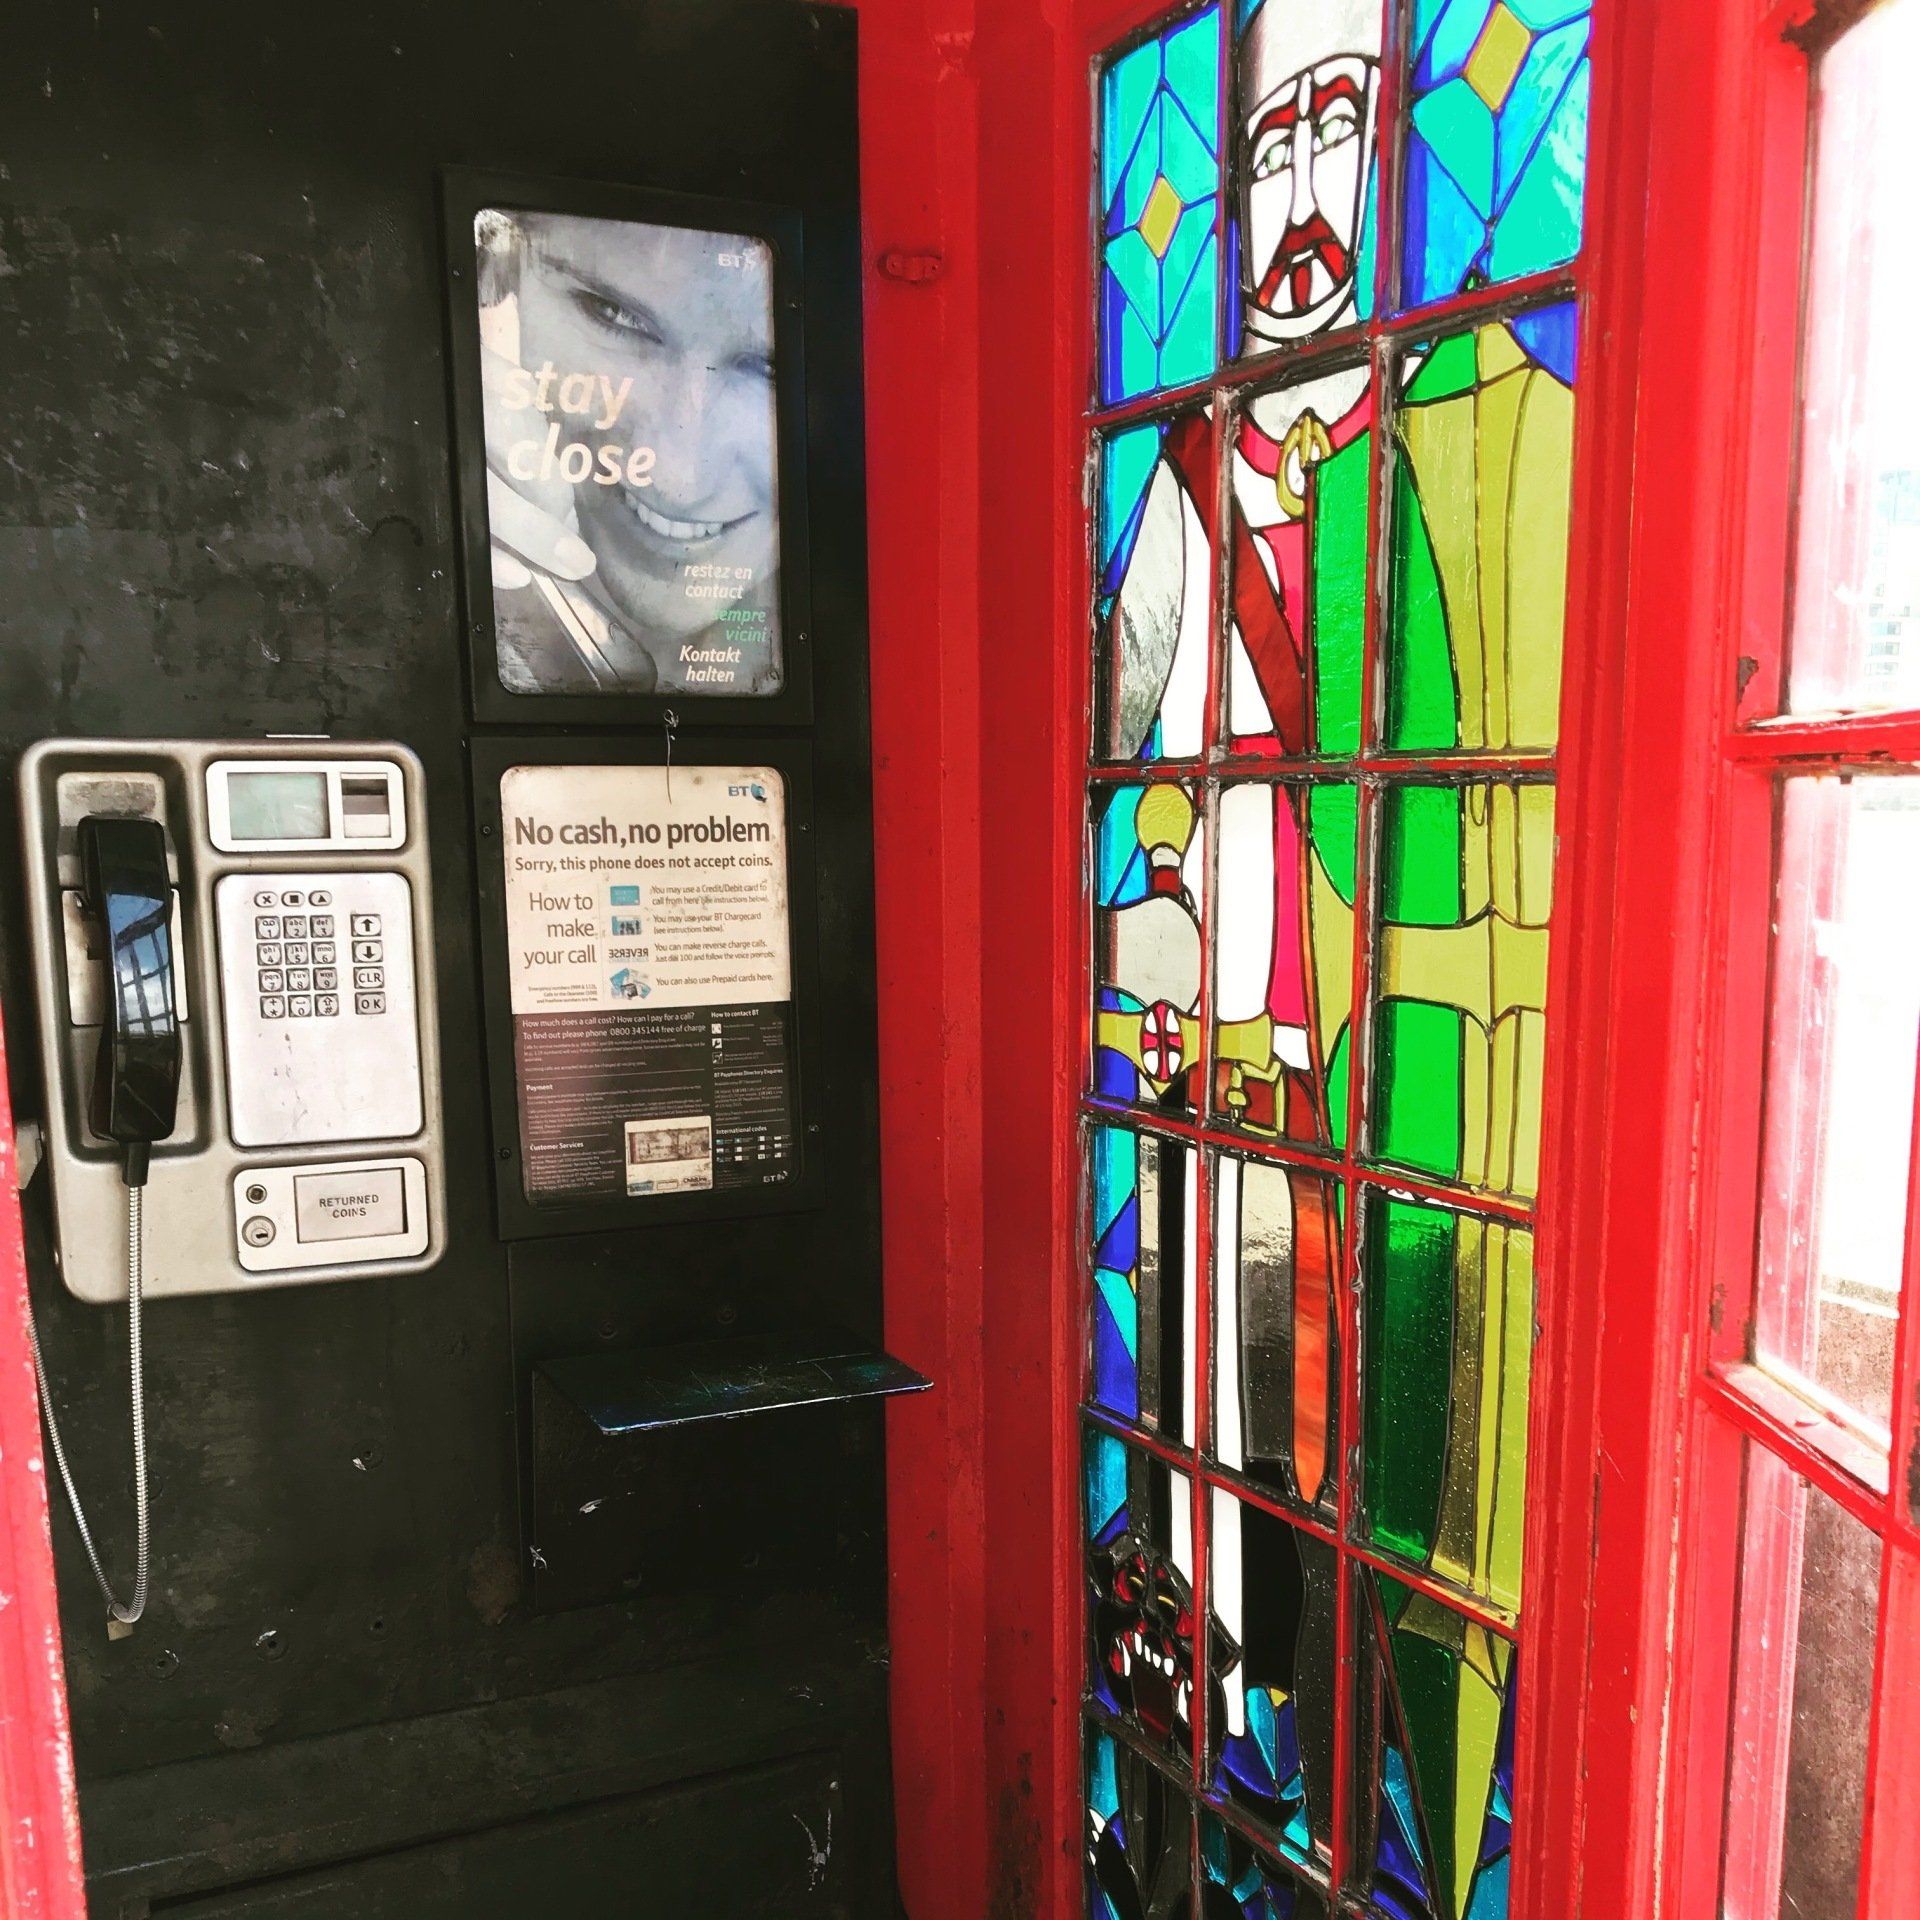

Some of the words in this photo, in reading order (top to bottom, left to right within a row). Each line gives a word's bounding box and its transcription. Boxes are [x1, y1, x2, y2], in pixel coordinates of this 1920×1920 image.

[718, 253, 742, 267] BT
[500, 361, 634, 430] stay
[507, 422, 656, 487] close
[684, 564, 731, 579] restez
[734, 567, 753, 580] en
[685, 584, 744, 600] contact
[726, 626, 768, 642] vicini
[679, 645, 742, 663] Kontakt
[685, 665, 735, 682] halten
[728, 785, 749, 797] BT
[515, 816, 554, 845] No
[560, 816, 626, 849] cash,
[629, 823, 662, 844] no
[667, 815, 770, 850] problem
[515, 857, 558, 874] Sorry,
[560, 857, 586, 871] this
[590, 856, 632, 873] phone
[634, 855, 666, 870] does
[668, 856, 691, 869] not
[694, 855, 736, 871] accept
[738, 854, 773, 868] coins.
[651, 885, 665, 895] You
[666, 886, 681, 895] may
[702, 884, 743, 894] Credit/Debit
[743, 884, 759, 892] card
[529, 892, 571, 911] How
[574, 893, 594, 910] to
[652, 897, 664, 905] call
[665, 896, 683, 905] from
[684, 896, 698, 904] here
[653, 914, 666, 923] You
[667, 915, 681, 924] may
[684, 915, 697, 923] use
[697, 915, 713, 924] your
[714, 912, 722, 921] BT
[724, 912, 761, 922] Chargecard
[267, 930, 272, 938] 1
[294, 929, 300, 937] 2
[321, 928, 327, 936] 3
[547, 918, 594, 938] make
[262, 947, 276, 955] ghi
[291, 946, 303, 955] jkl
[655, 942, 667, 951] You
[668, 943, 681, 951] can
[683, 942, 701, 950] make
[702, 942, 728, 950] reverse
[728, 940, 751, 950] charge
[524, 950, 565, 969] your
[568, 944, 597, 964] call
[693, 953, 705, 961] and
[358, 972, 381, 983] CLR
[656, 977, 669, 986] You
[670, 977, 683, 985] can
[684, 976, 698, 984] also
[698, 976, 711, 984] use
[711, 974, 737, 984] Prepaid
[738, 973, 756, 982] cards
[297, 981, 303, 989] 8
[361, 999, 381, 1009] OK
[298, 1007, 304, 1015] 0
[522, 1019, 540, 1028] How
[540, 1018, 560, 1027] much
[561, 1018, 578, 1026] does
[584, 1016, 597, 1025] call
[597, 1015, 616, 1025] cost?
[617, 1015, 633, 1023] How
[650, 1015, 663, 1023] pay
[663, 1013, 674, 1021] for
[680, 1011, 695, 1020] call?
[523, 1032, 532, 1040] To
[532, 1031, 547, 1040] find
[548, 1031, 560, 1039] out
[562, 1030, 585, 1040] please
[585, 1029, 608, 1038] phone
[610, 1027, 630, 1036] 0800
[631, 1026, 660, 1035] 345144
[661, 1025, 675, 1033] free
[675, 1024, 683, 1032] of
[683, 1024, 706, 1033] charge
[526, 1084, 553, 1092] Payment
[716, 1126, 751, 1135] International
[751, 1125, 767, 1133] codes
[530, 1143, 559, 1151] Customer
[559, 1142, 584, 1150] Services
[319, 1194, 379, 1208] RETURNED
[332, 1207, 367, 1219] COINS
